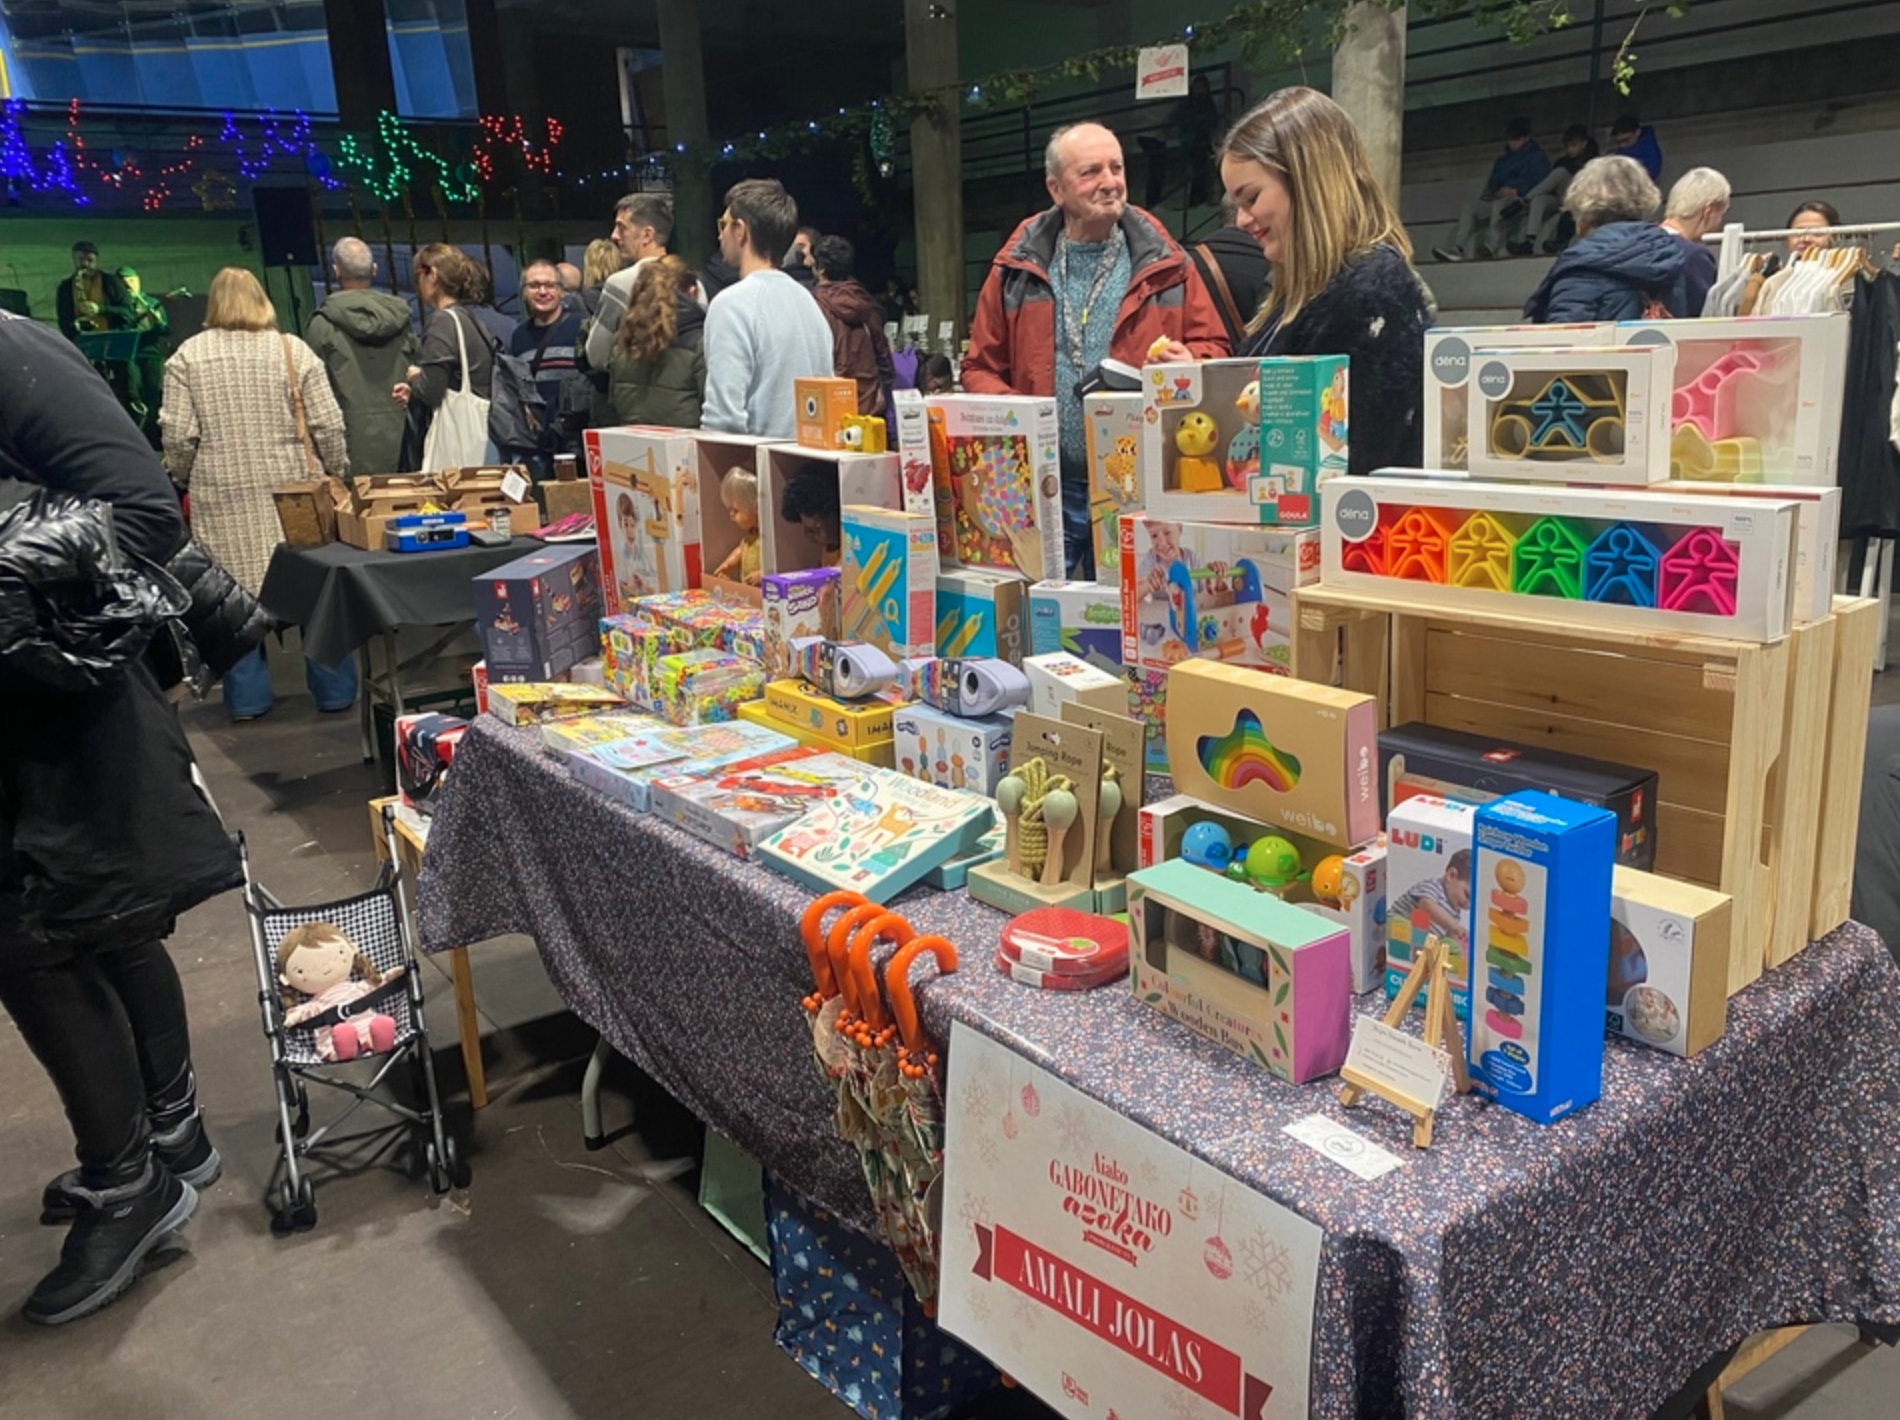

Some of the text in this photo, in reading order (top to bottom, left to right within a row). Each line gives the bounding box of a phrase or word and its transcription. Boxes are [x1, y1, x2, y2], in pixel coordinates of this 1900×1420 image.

[1026, 741, 1059, 762] Jumping
[1061, 749, 1083, 767] Rope
[1049, 1158, 1172, 1238] GABONETAKO
[1091, 1152, 1129, 1186] Aiako
[1062, 1195, 1156, 1254] azoka
[1018, 1249, 1203, 1384] AMALI JOLAS
